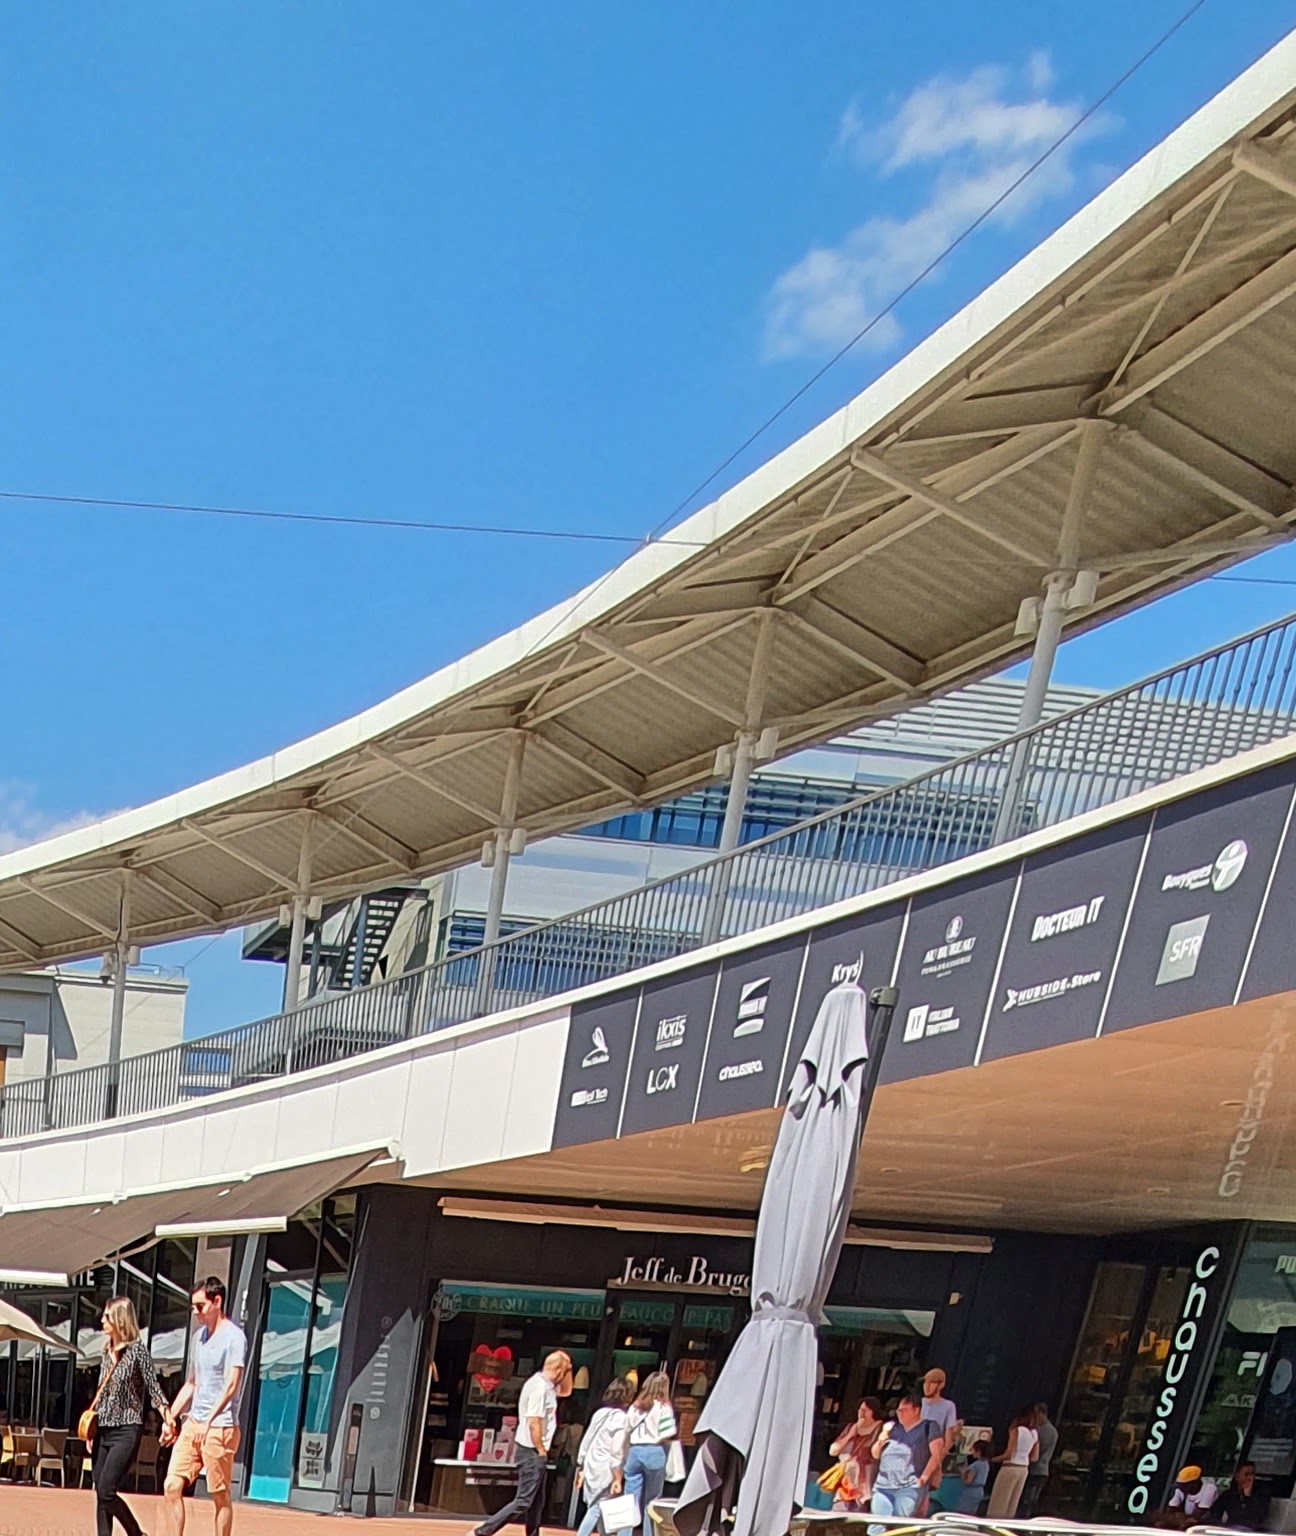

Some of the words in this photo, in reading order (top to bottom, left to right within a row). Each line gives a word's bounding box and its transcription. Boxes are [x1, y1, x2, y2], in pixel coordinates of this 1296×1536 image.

[1031, 904, 1088, 942] DOCTEUR
[1086, 896, 1105, 925] IT
[1169, 935, 1201, 963] SFR
[615, 1256, 665, 1285] Jeff
[664, 1267, 683, 1284] de
[684, 1256, 751, 1296] Brug
[1128, 1246, 1219, 1514] chaussea
